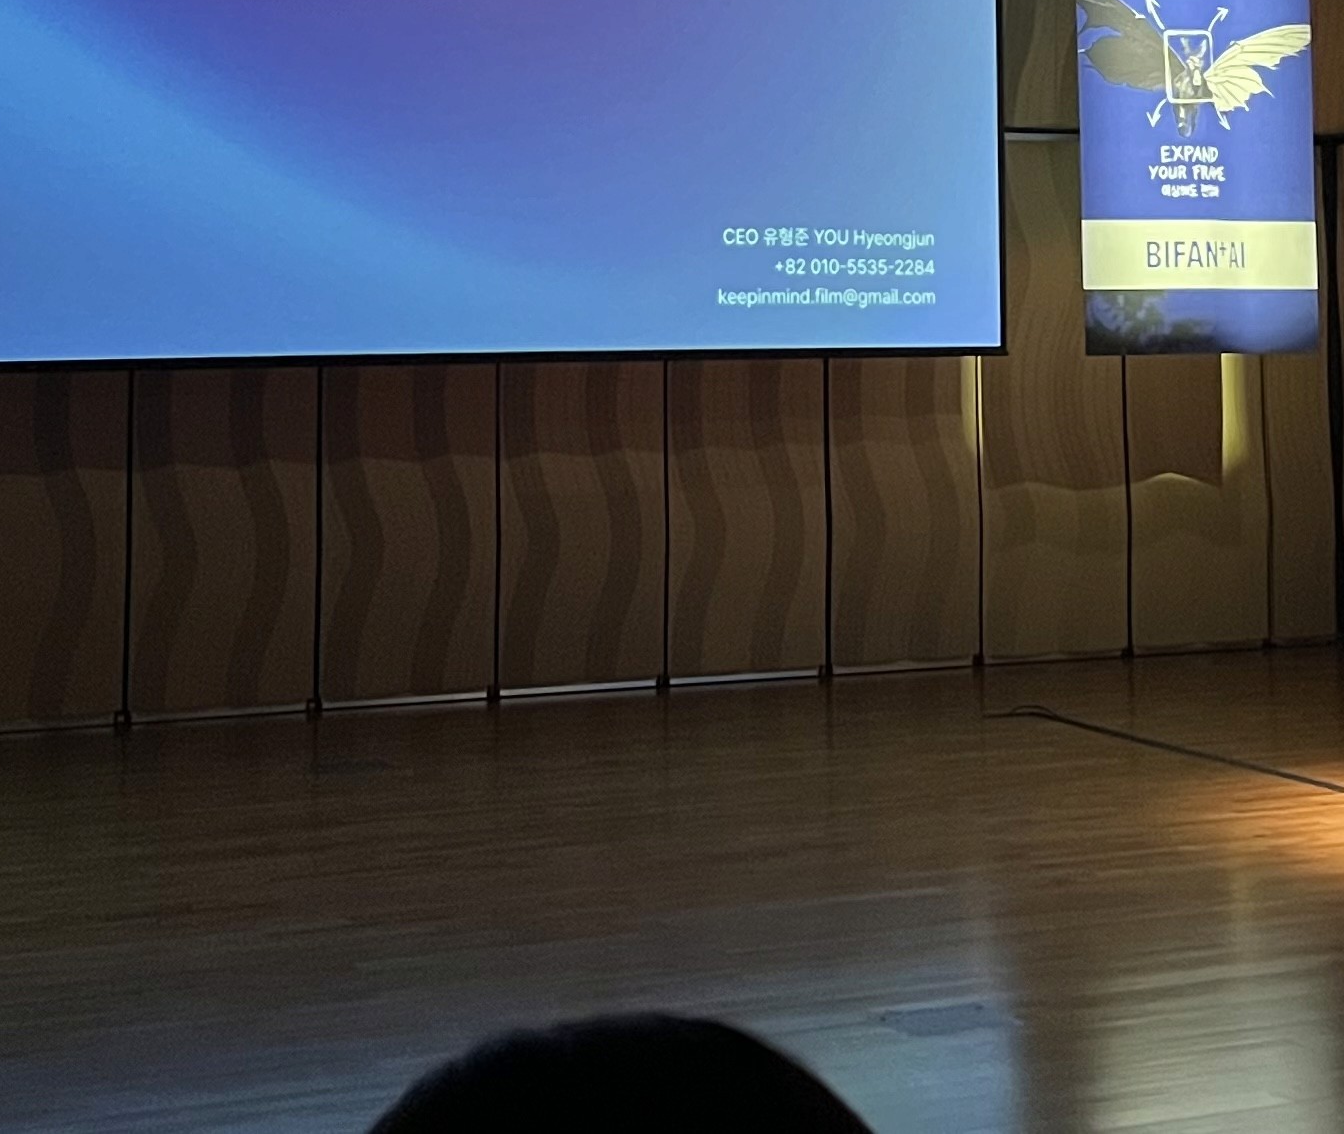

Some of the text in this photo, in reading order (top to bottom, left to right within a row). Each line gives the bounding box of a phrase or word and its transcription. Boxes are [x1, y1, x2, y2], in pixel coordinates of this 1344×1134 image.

[1160, 145, 1219, 163] EXPAND
[1148, 164, 1187, 180] YOUR
[722, 226, 935, 250] CEO 유형준 YOU Hyeongjun
[774, 257, 936, 276] +82 010-5535-2284
[717, 286, 937, 309] keepinmind.film@gmail.com
